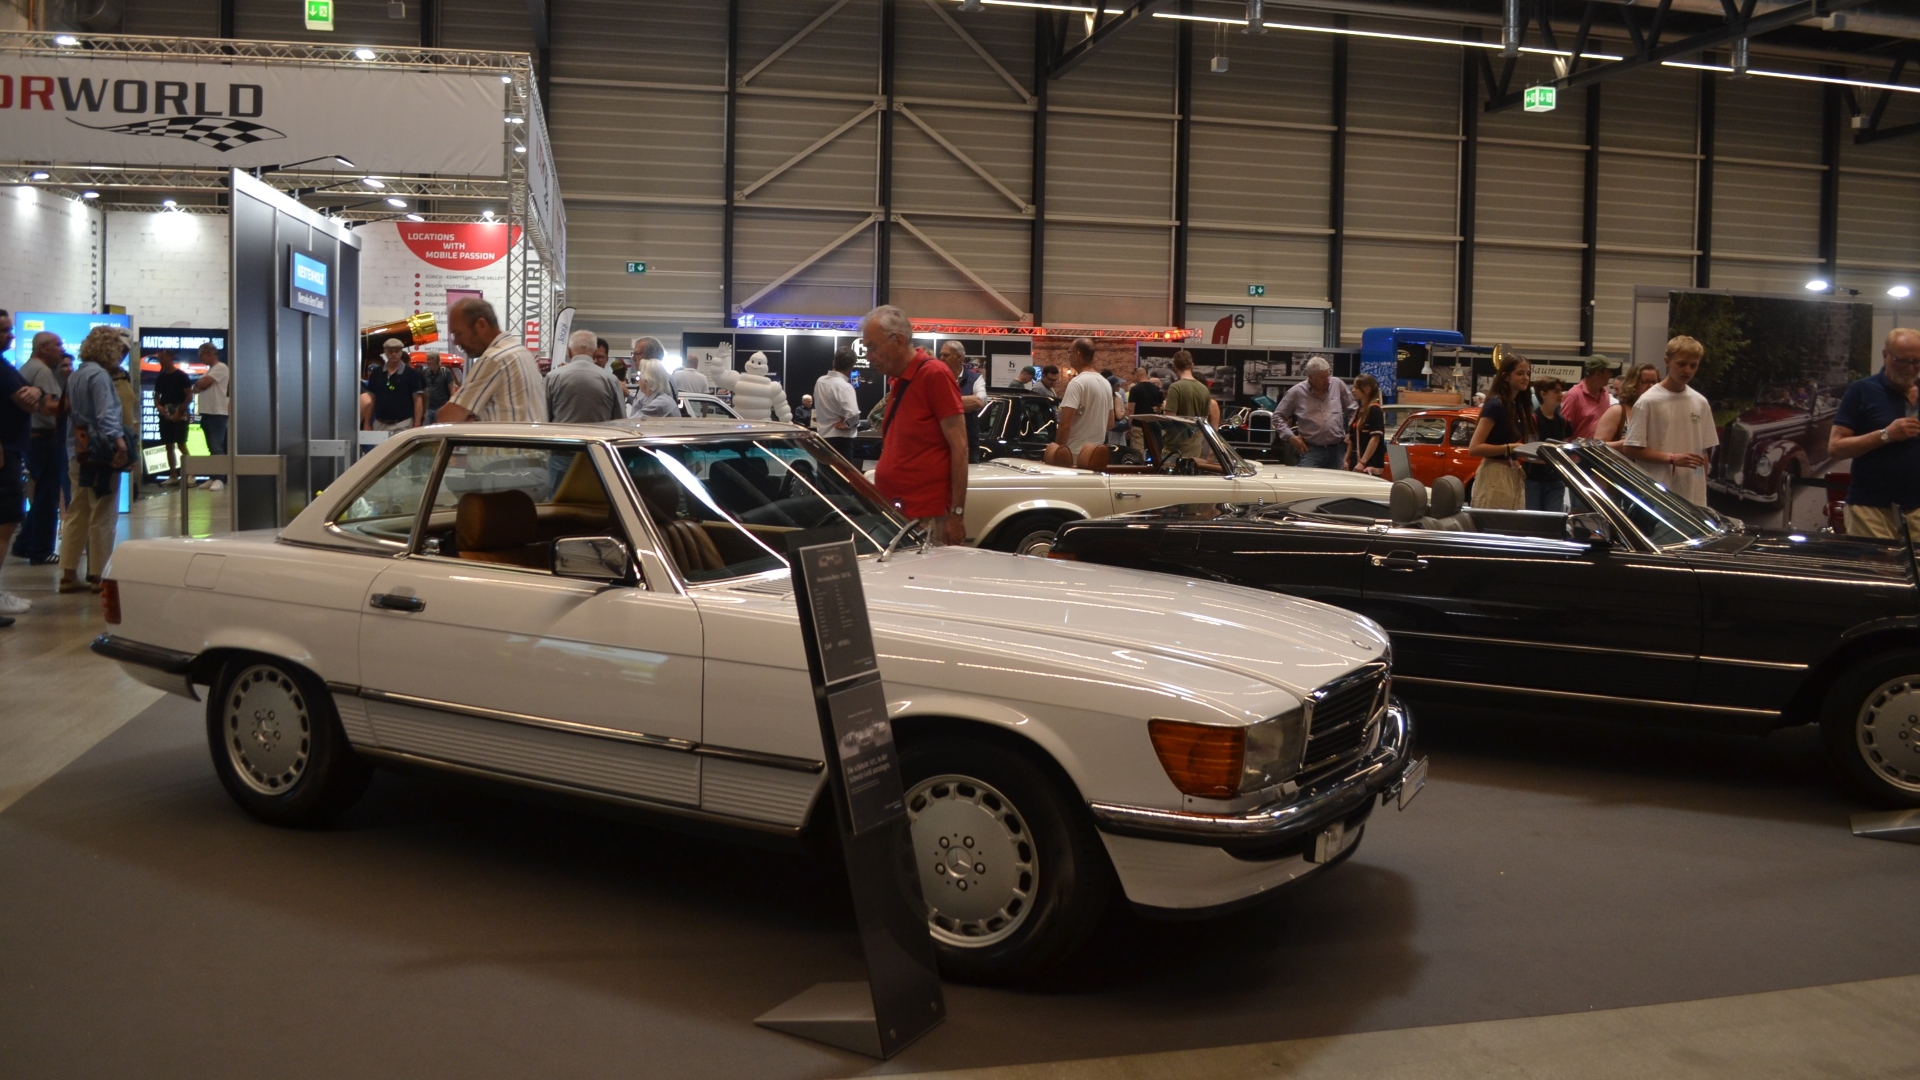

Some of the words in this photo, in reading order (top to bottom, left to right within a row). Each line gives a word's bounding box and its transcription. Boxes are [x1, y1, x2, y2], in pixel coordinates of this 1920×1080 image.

[407, 232, 455, 241] LOCATIONS
[443, 242, 466, 250] WITH
[425, 251, 458, 259] MOBILE
[459, 251, 496, 260] PASSION
[142, 336, 180, 349] MATCHING
[143, 424, 160, 432] PARTS
